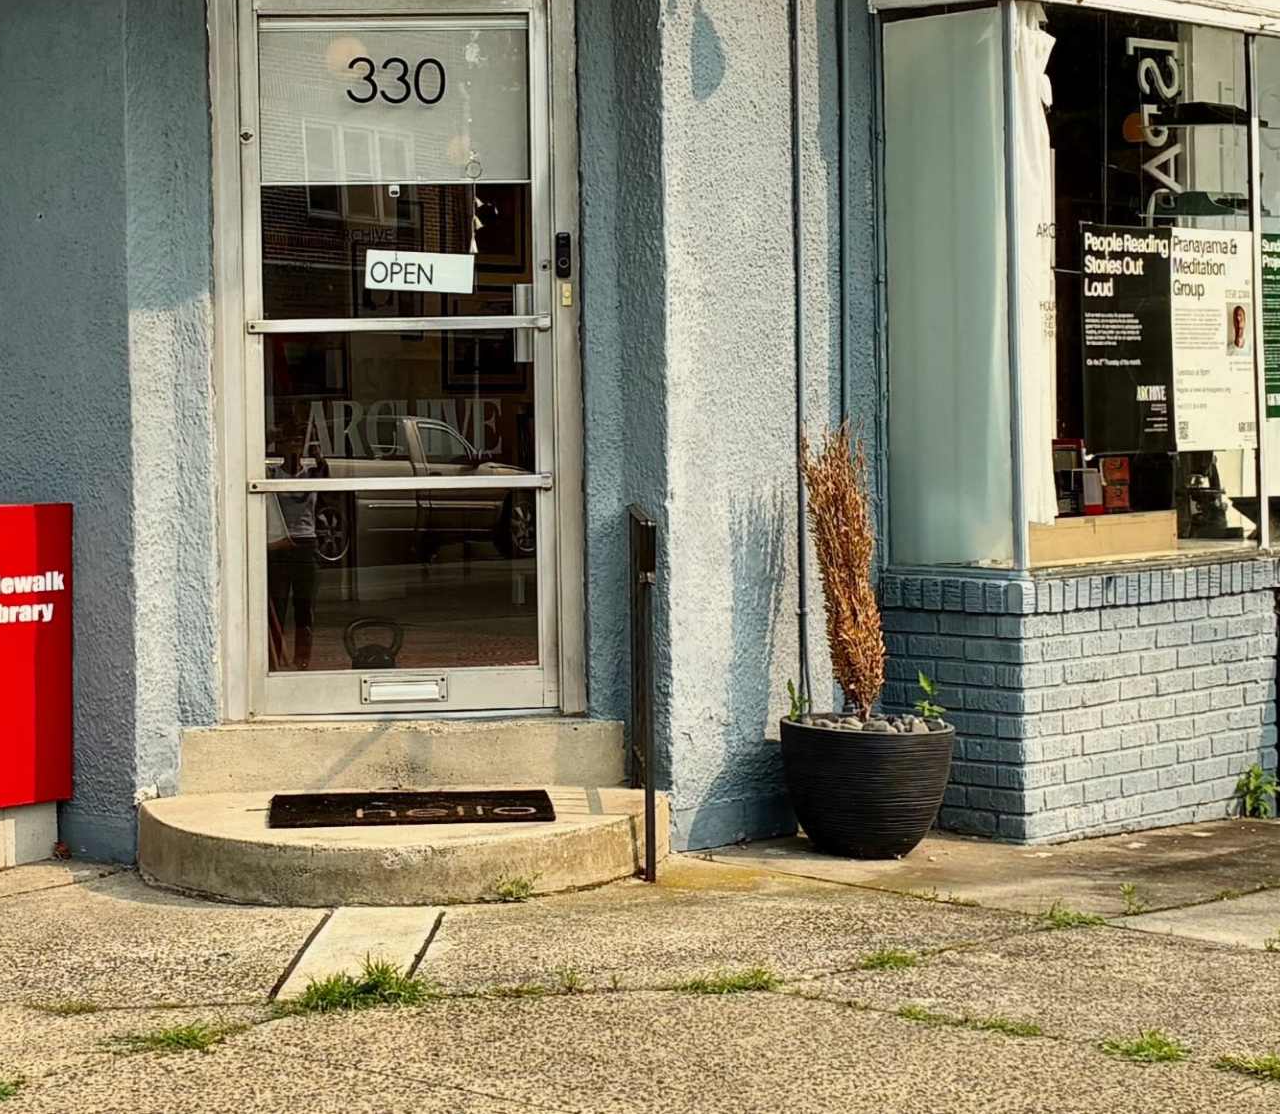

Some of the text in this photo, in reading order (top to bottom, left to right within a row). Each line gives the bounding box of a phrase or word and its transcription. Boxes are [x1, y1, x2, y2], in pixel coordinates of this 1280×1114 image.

[346, 56, 446, 104] 330
[1084, 232, 1169, 258] People Reading
[1173, 235, 1237, 257] Pranayama &
[370, 261, 433, 286] OPEN
[1084, 254, 1144, 275] Stories Out
[1173, 257, 1226, 276] Meditation
[1084, 277, 1114, 297] Loud
[1173, 279, 1205, 300] Group
[303, 398, 503, 458] ARCHIVE
[356, 805, 536, 818] hello
